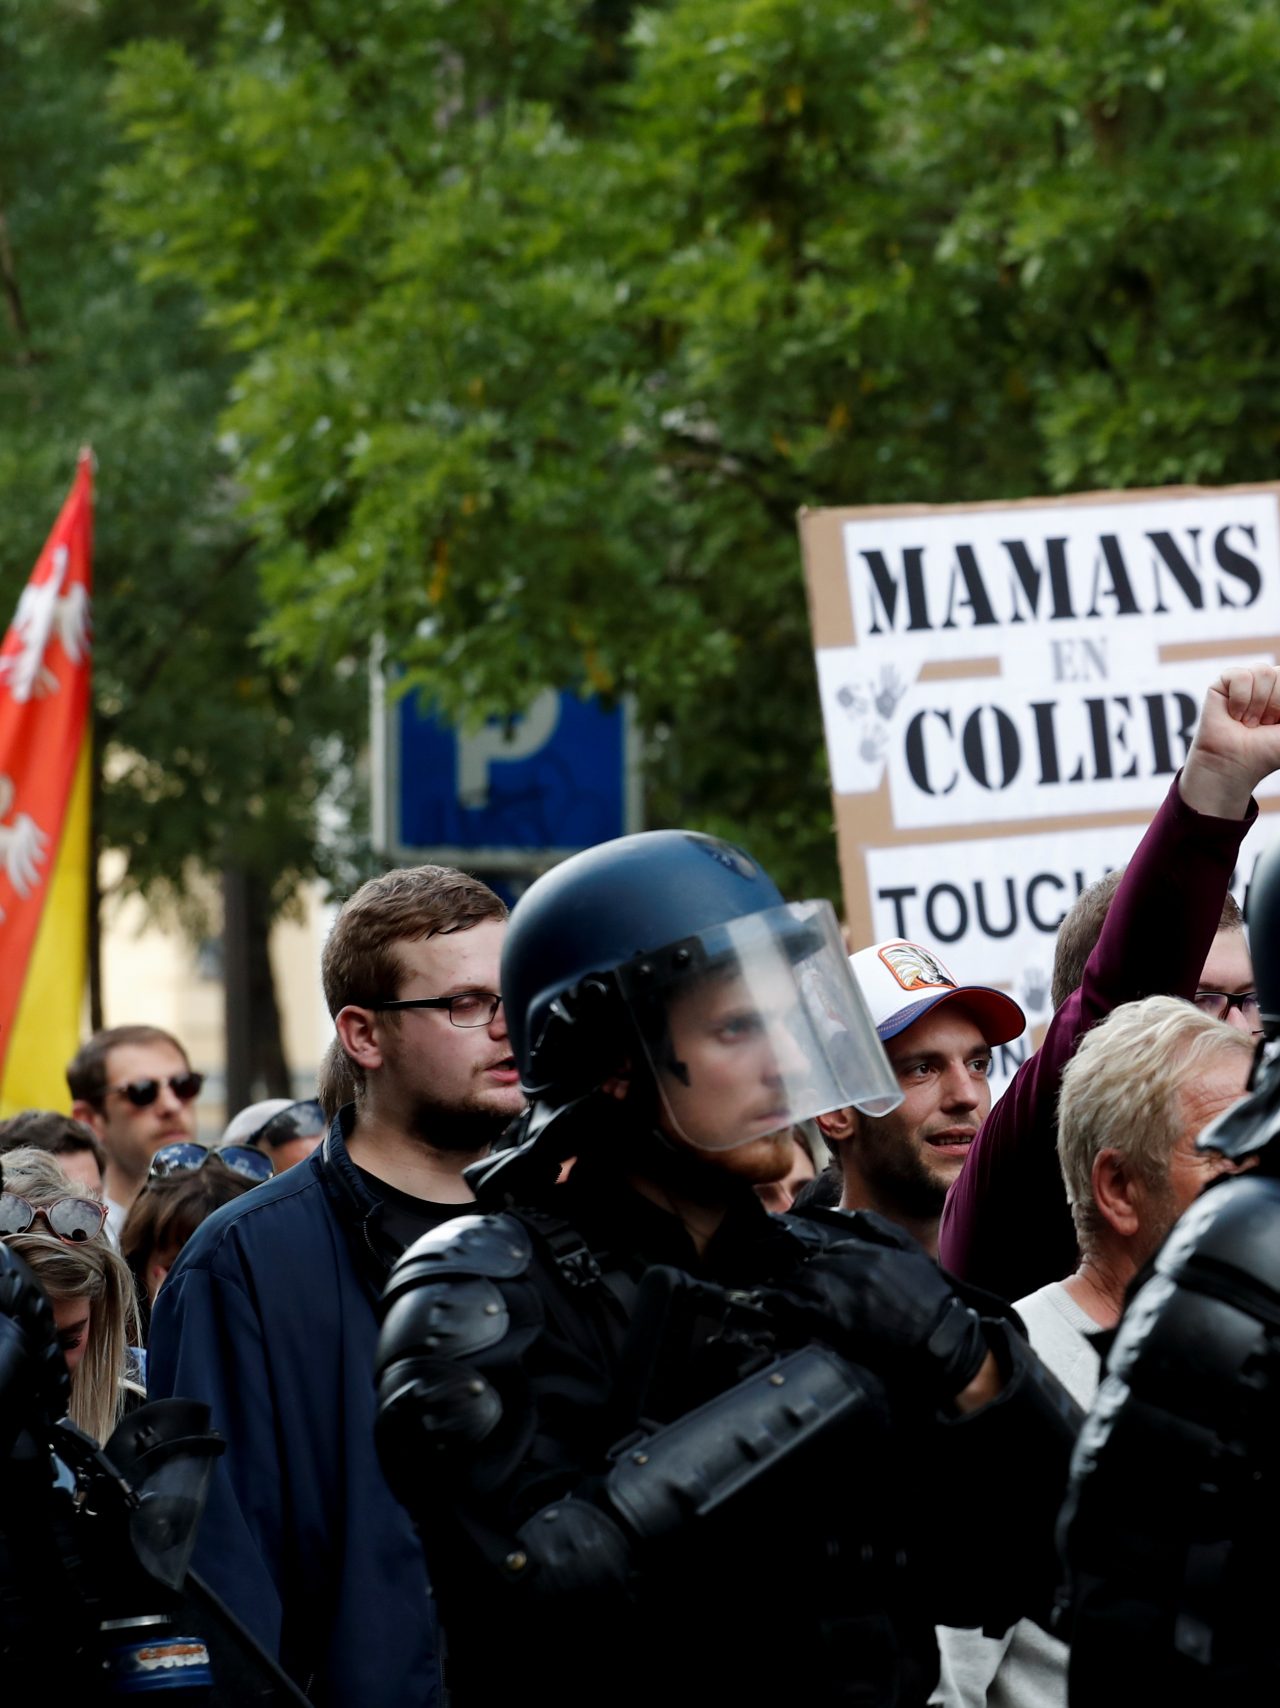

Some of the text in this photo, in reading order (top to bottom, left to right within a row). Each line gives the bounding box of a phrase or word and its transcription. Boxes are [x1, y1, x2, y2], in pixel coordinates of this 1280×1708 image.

[859, 525, 1263, 634] MAMANS
[1050, 638, 1109, 683] EN
[456, 684, 561, 808] P
[905, 691, 1198, 796] COLER
